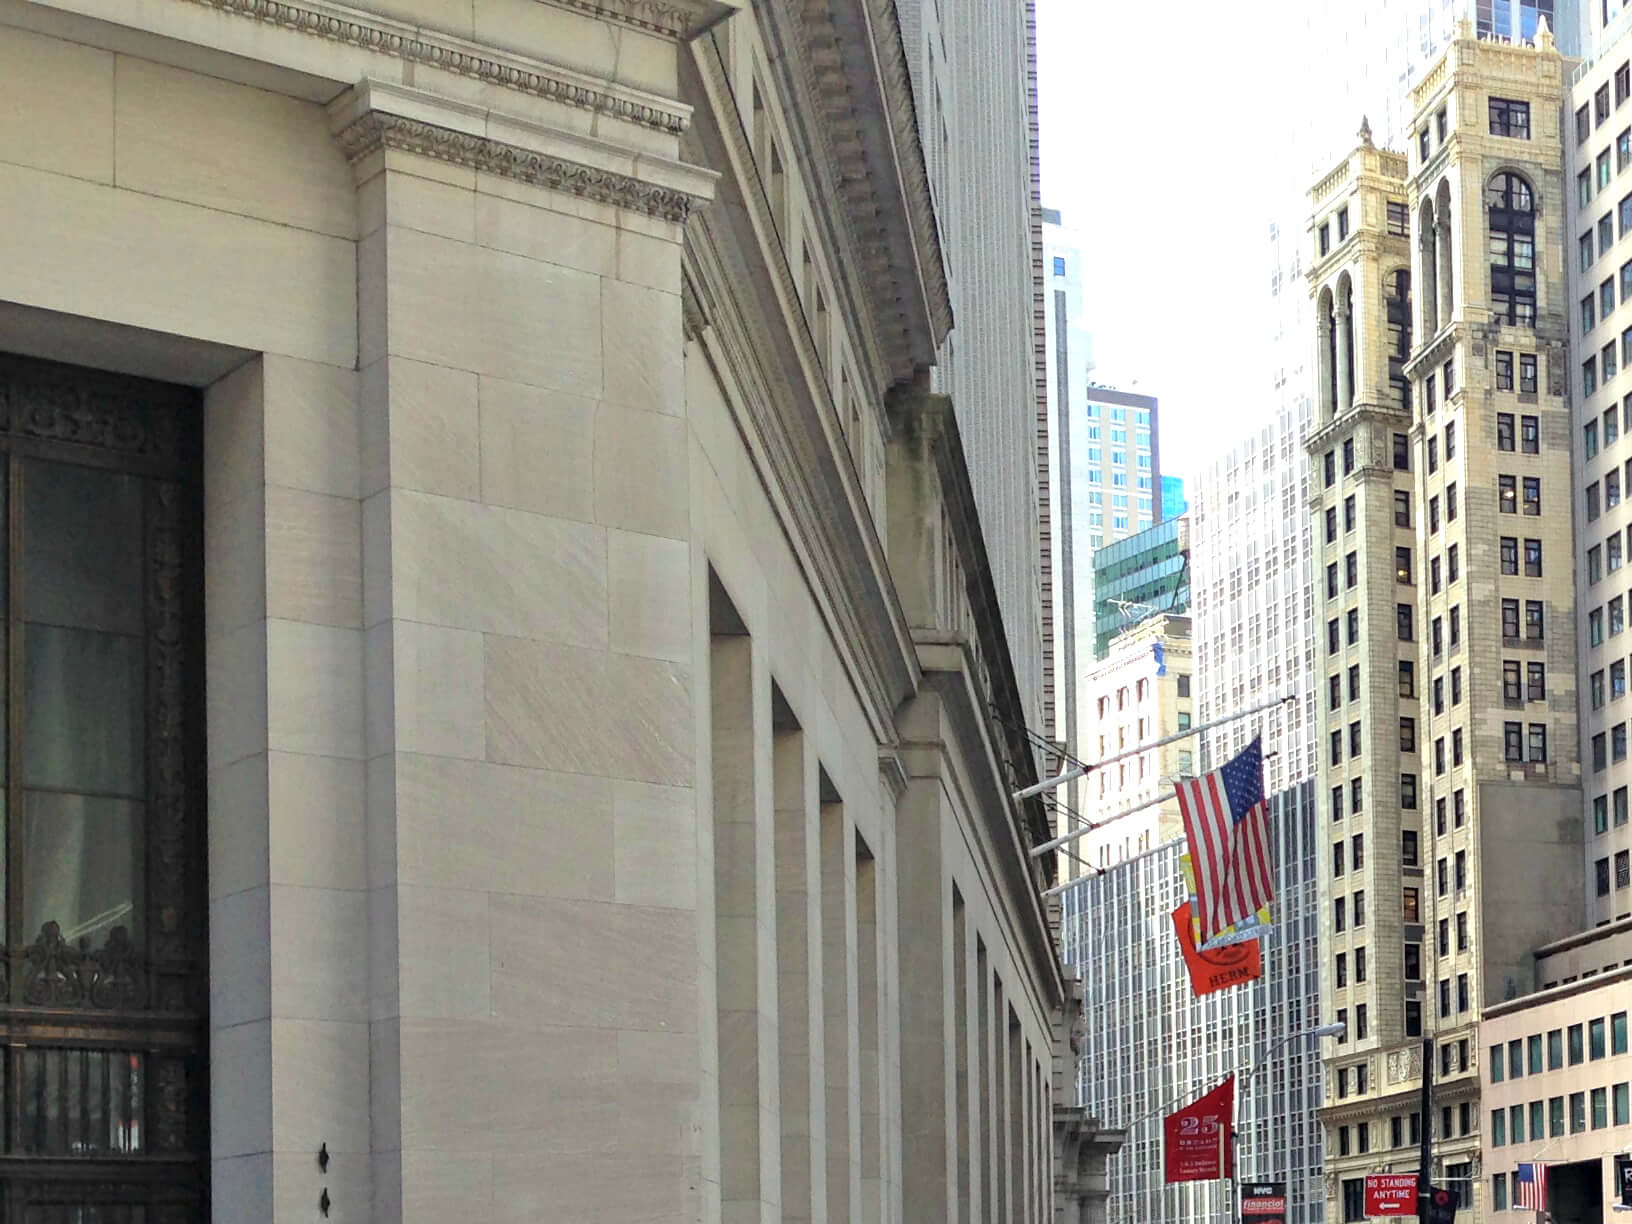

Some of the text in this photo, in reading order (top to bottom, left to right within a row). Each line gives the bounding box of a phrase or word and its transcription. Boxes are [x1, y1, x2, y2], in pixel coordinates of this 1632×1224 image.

[1179, 1114, 1219, 1135] 25
[1367, 1177, 1417, 1188] NO STANDING
[1373, 1190, 1411, 1199] ANYTIME
[1243, 1199, 1284, 1209] financial
